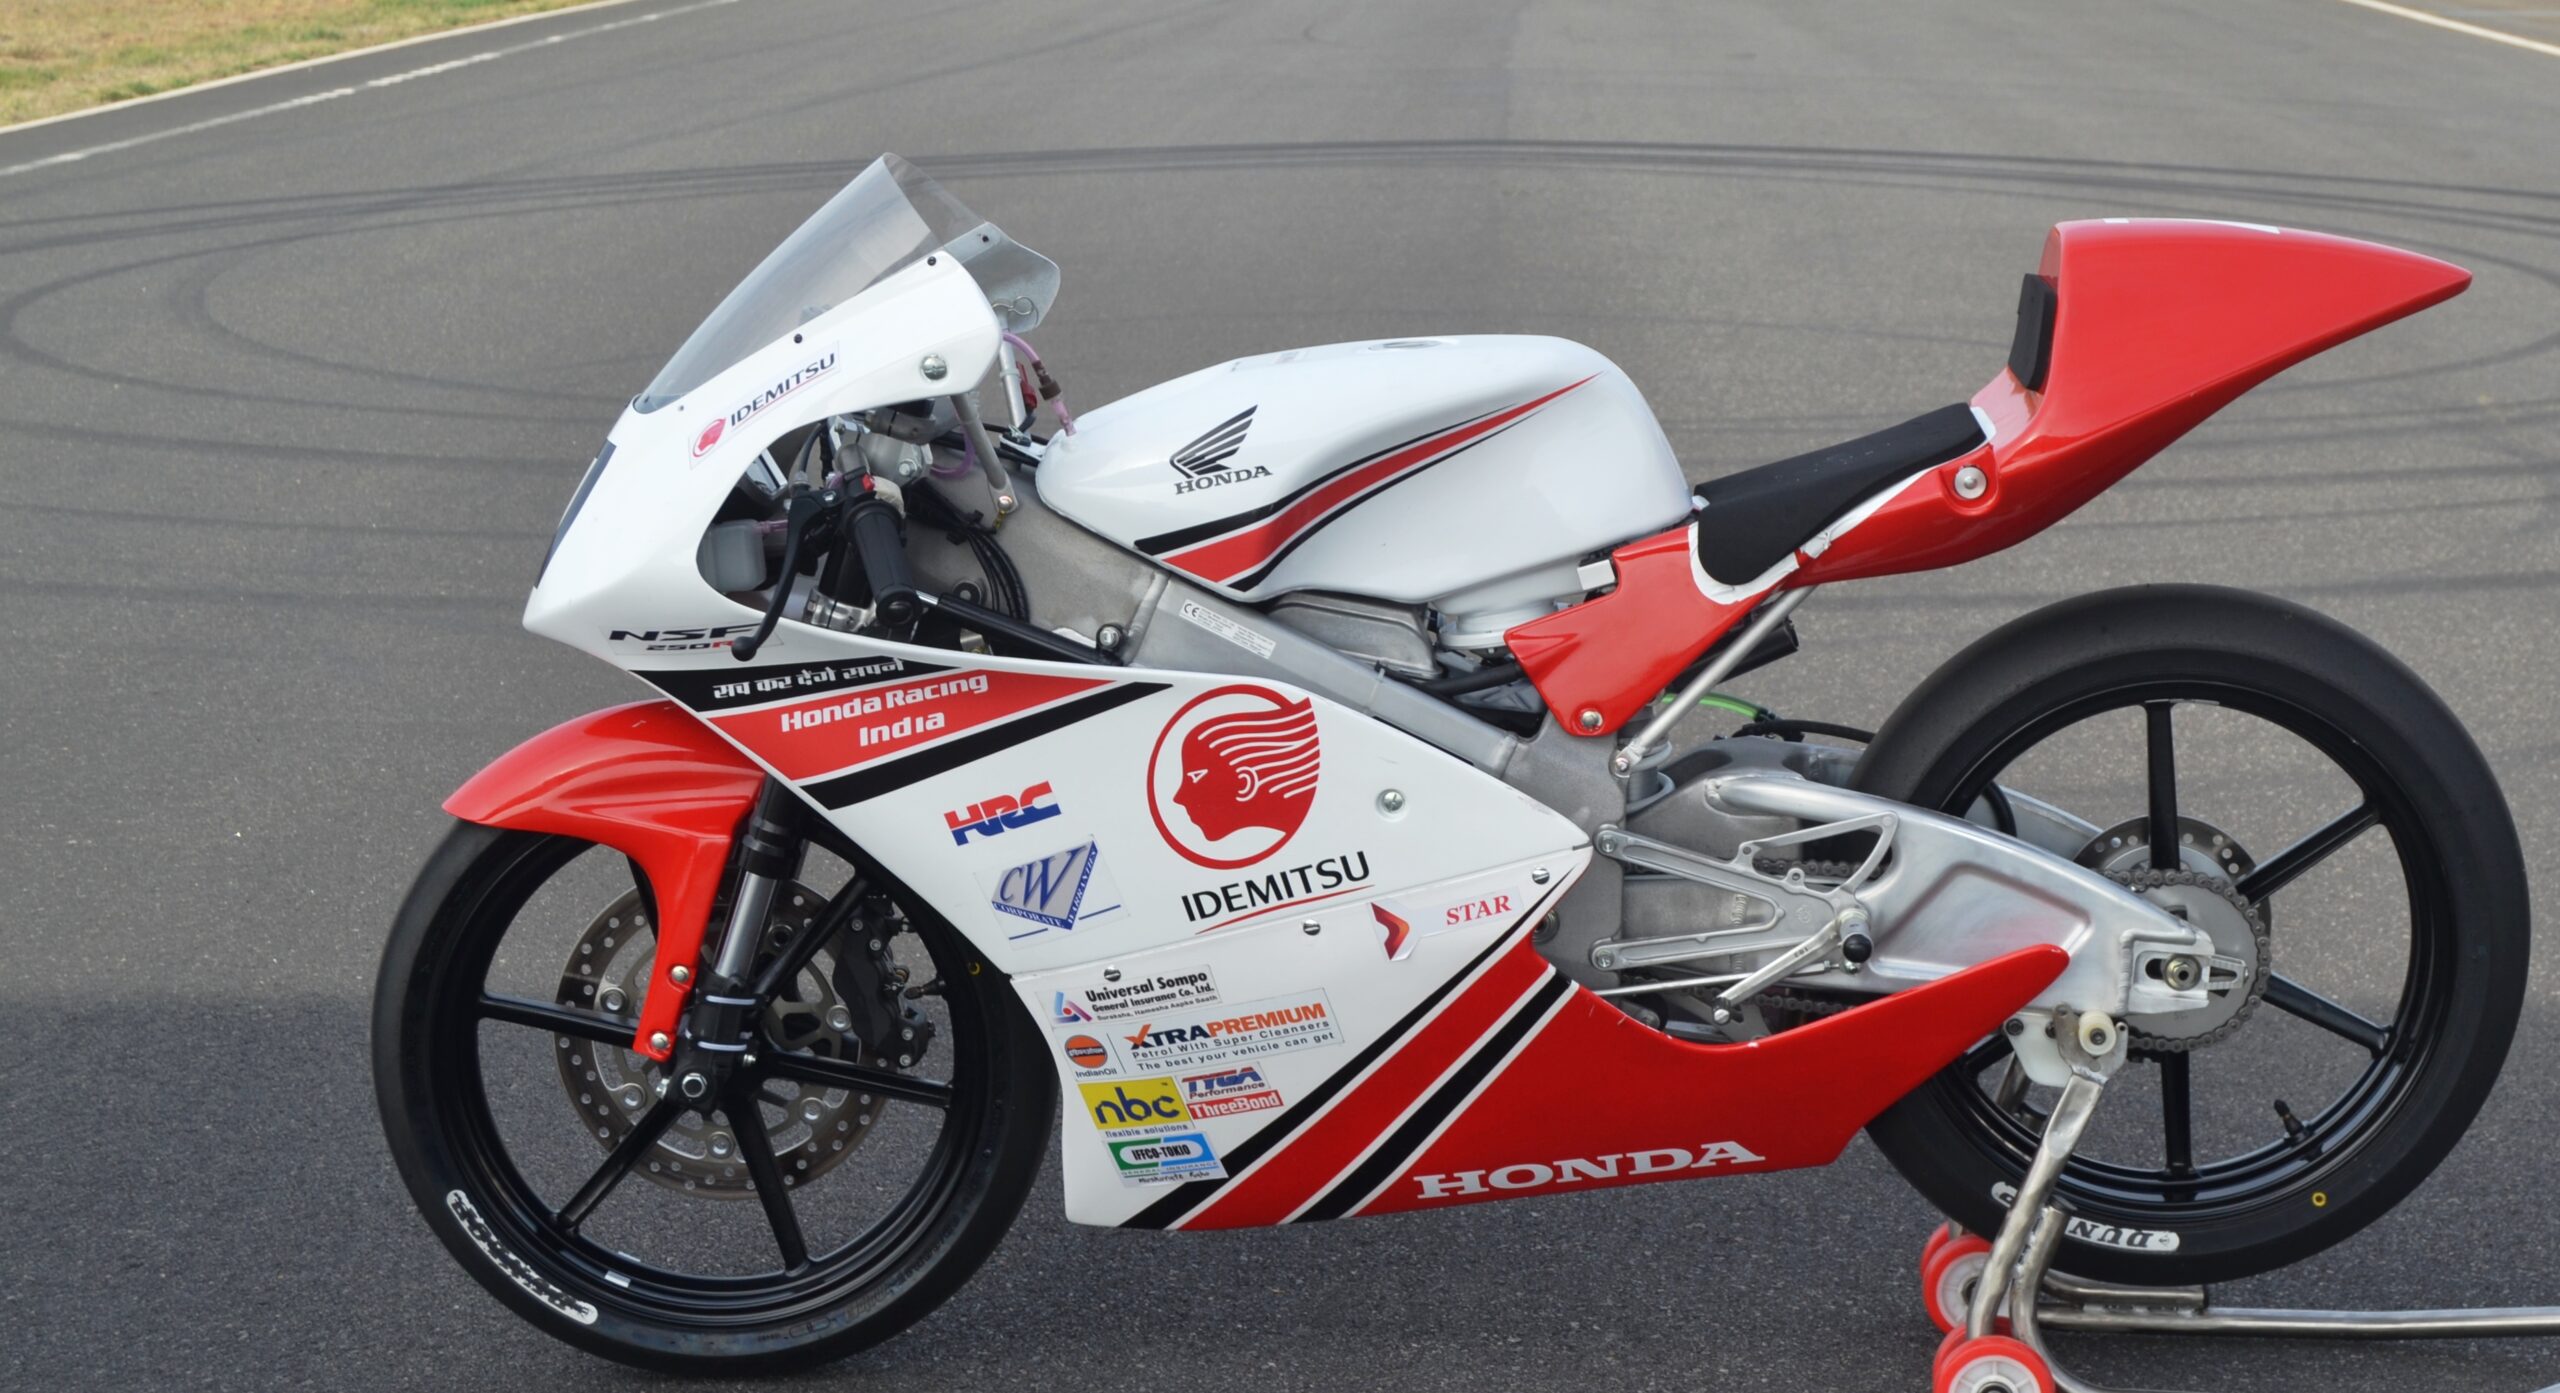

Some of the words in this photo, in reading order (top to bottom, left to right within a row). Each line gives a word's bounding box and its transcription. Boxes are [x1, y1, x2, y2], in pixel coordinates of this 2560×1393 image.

[731, 352, 835, 426] IDEMITSU
[1173, 465, 1273, 495] HONDA
[1184, 603, 1200, 617] CE
[609, 623, 761, 641] NSF
[754, 676, 793, 692] कर
[780, 694, 883, 732] Honda
[885, 674, 988, 708] Racing
[859, 711, 945, 747] India
[944, 780, 1062, 846] HRC
[1000, 845, 1088, 912] CW
[1181, 851, 1370, 922] IDEMITSU
[993, 903, 1062, 927] CORPORATE
[1446, 895, 1512, 926] STAR
[1085, 979, 1154, 1002] Universal
[1157, 972, 1207, 990] Sompo
[1092, 999, 1129, 1013] General
[1131, 992, 1176, 1007] Insurance
[1179, 987, 1193, 998] Co.
[1196, 983, 1214, 994] Ltd.
[1134, 1003, 1169, 1016] Hamesha
[1132, 1047, 1173, 1060] Petrol
[1180, 1041, 1209, 1054] With
[1213, 1033, 1253, 1048] Super
[1259, 1020, 1330, 1040] Cleansers
[1137, 1061, 1161, 1072] The
[1166, 1056, 1194, 1068] best
[1198, 1052, 1228, 1066] your
[1233, 1042, 1280, 1057] vehicle
[1285, 1036, 1308, 1048] can
[1314, 1031, 1335, 1045] get
[1075, 1068, 1118, 1079] IndianOil
[1182, 1066, 1262, 1093] TYGA
[1095, 1086, 1180, 1124] nbc
[1189, 1081, 1265, 1100] Performance
[1189, 1090, 1281, 1119] ThreeBond
[1105, 1127, 1141, 1138] flexible
[1144, 1123, 1189, 1135] solutions
[1131, 1143, 1191, 1161] IFFCO-TOKIO
[1413, 1140, 1766, 1200] HONDA
